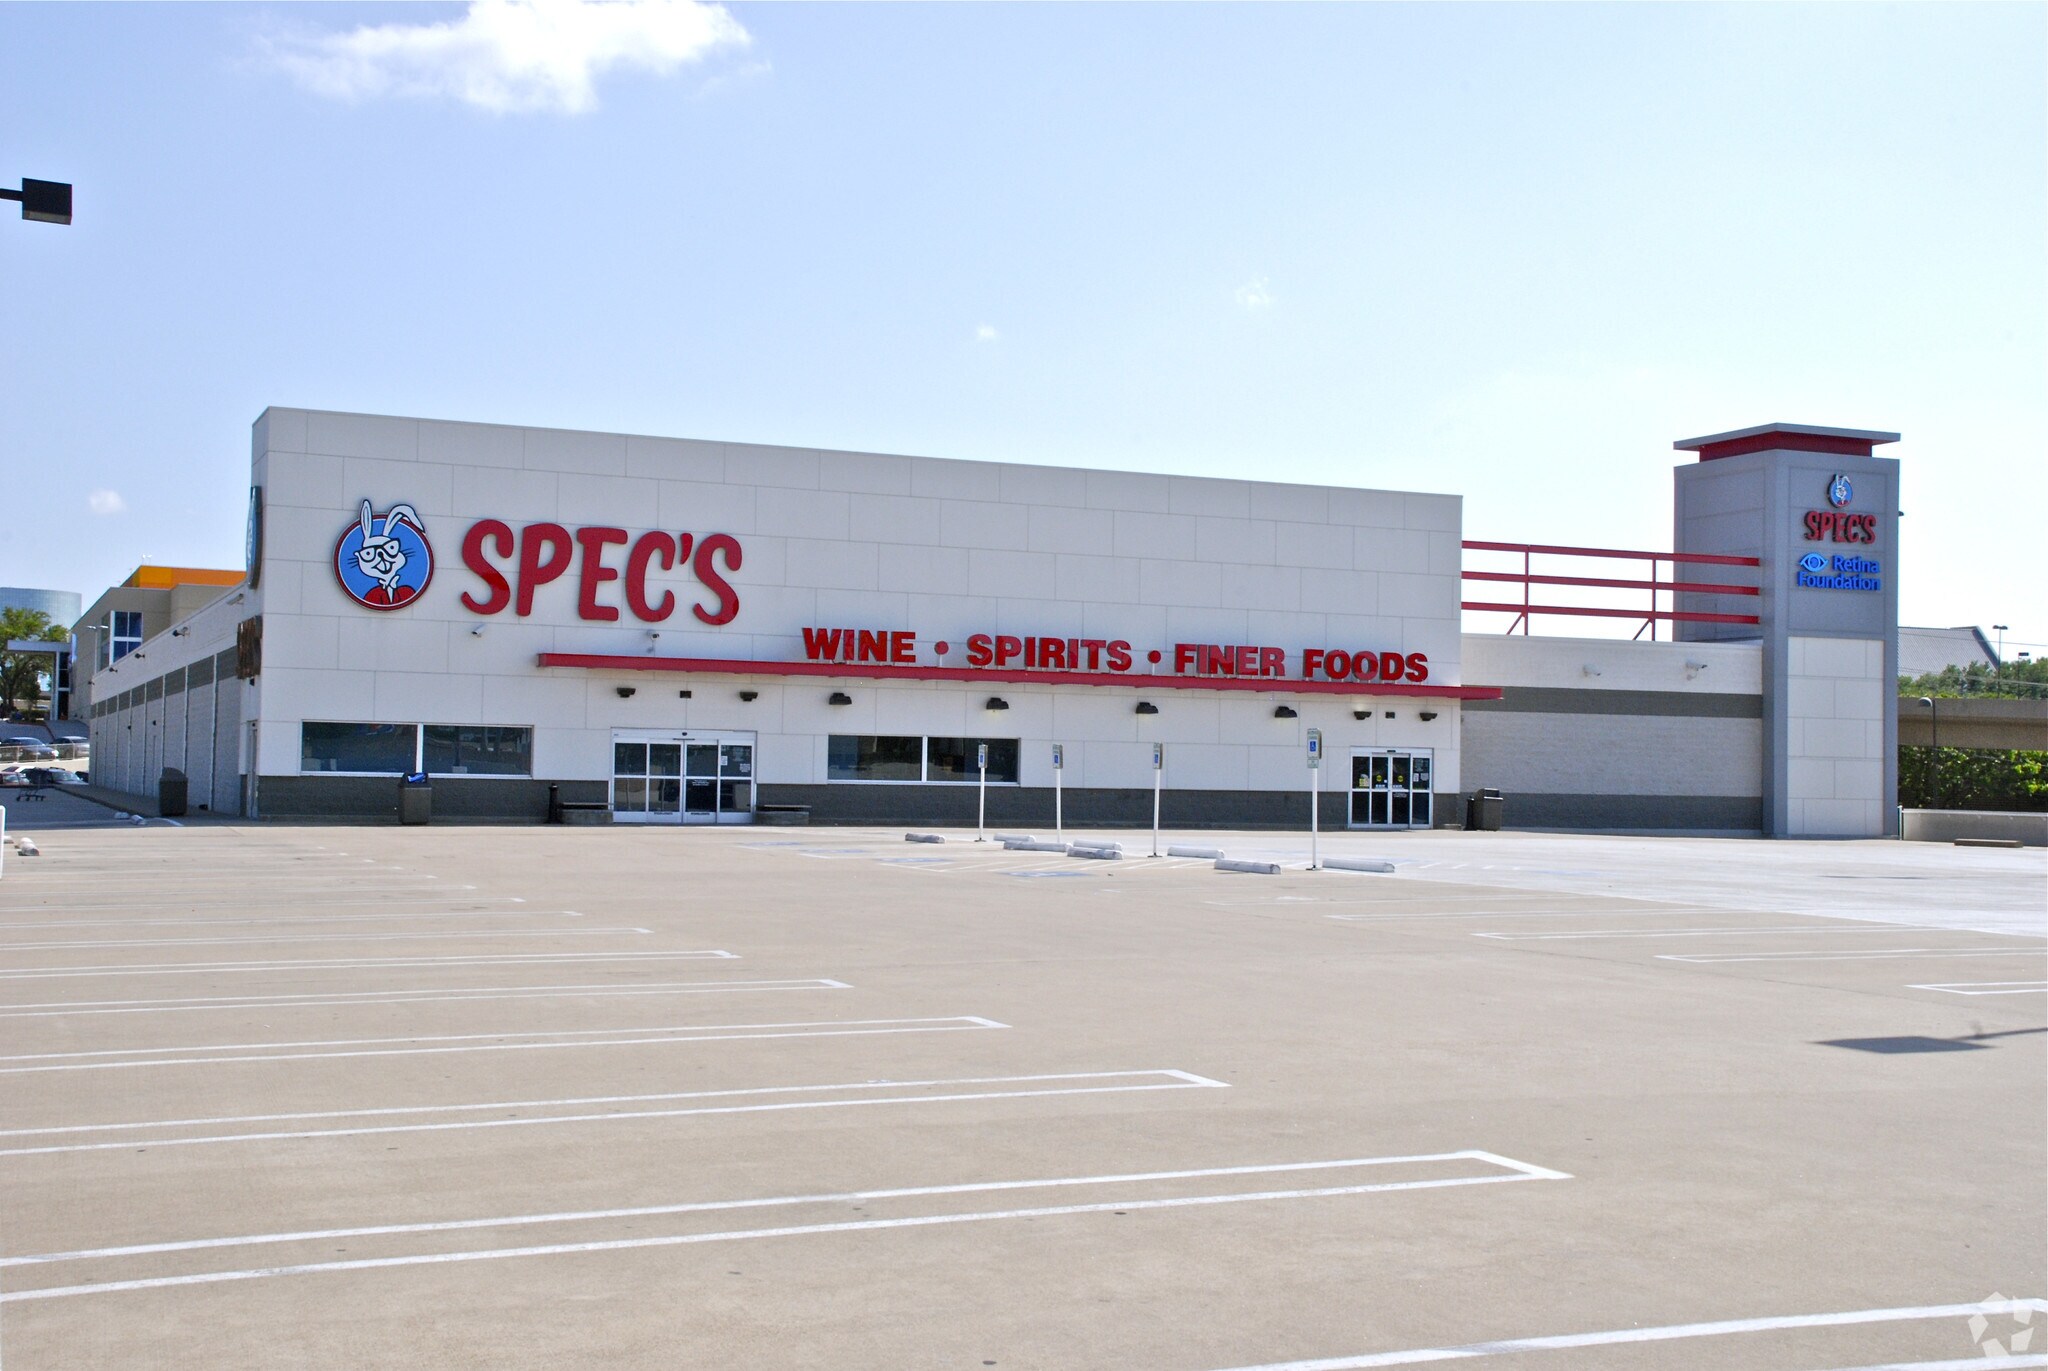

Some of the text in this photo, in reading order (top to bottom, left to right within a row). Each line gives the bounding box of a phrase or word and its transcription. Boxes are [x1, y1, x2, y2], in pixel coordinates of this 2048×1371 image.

[1803, 511, 1877, 544] SPEC'S
[461, 519, 743, 625] SPEC'S
[1797, 571, 1881, 590] Foundation
[1832, 555, 1880, 573] Retina
[802, 628, 1428, 682] WINE SPIRITS FINER FOODS
